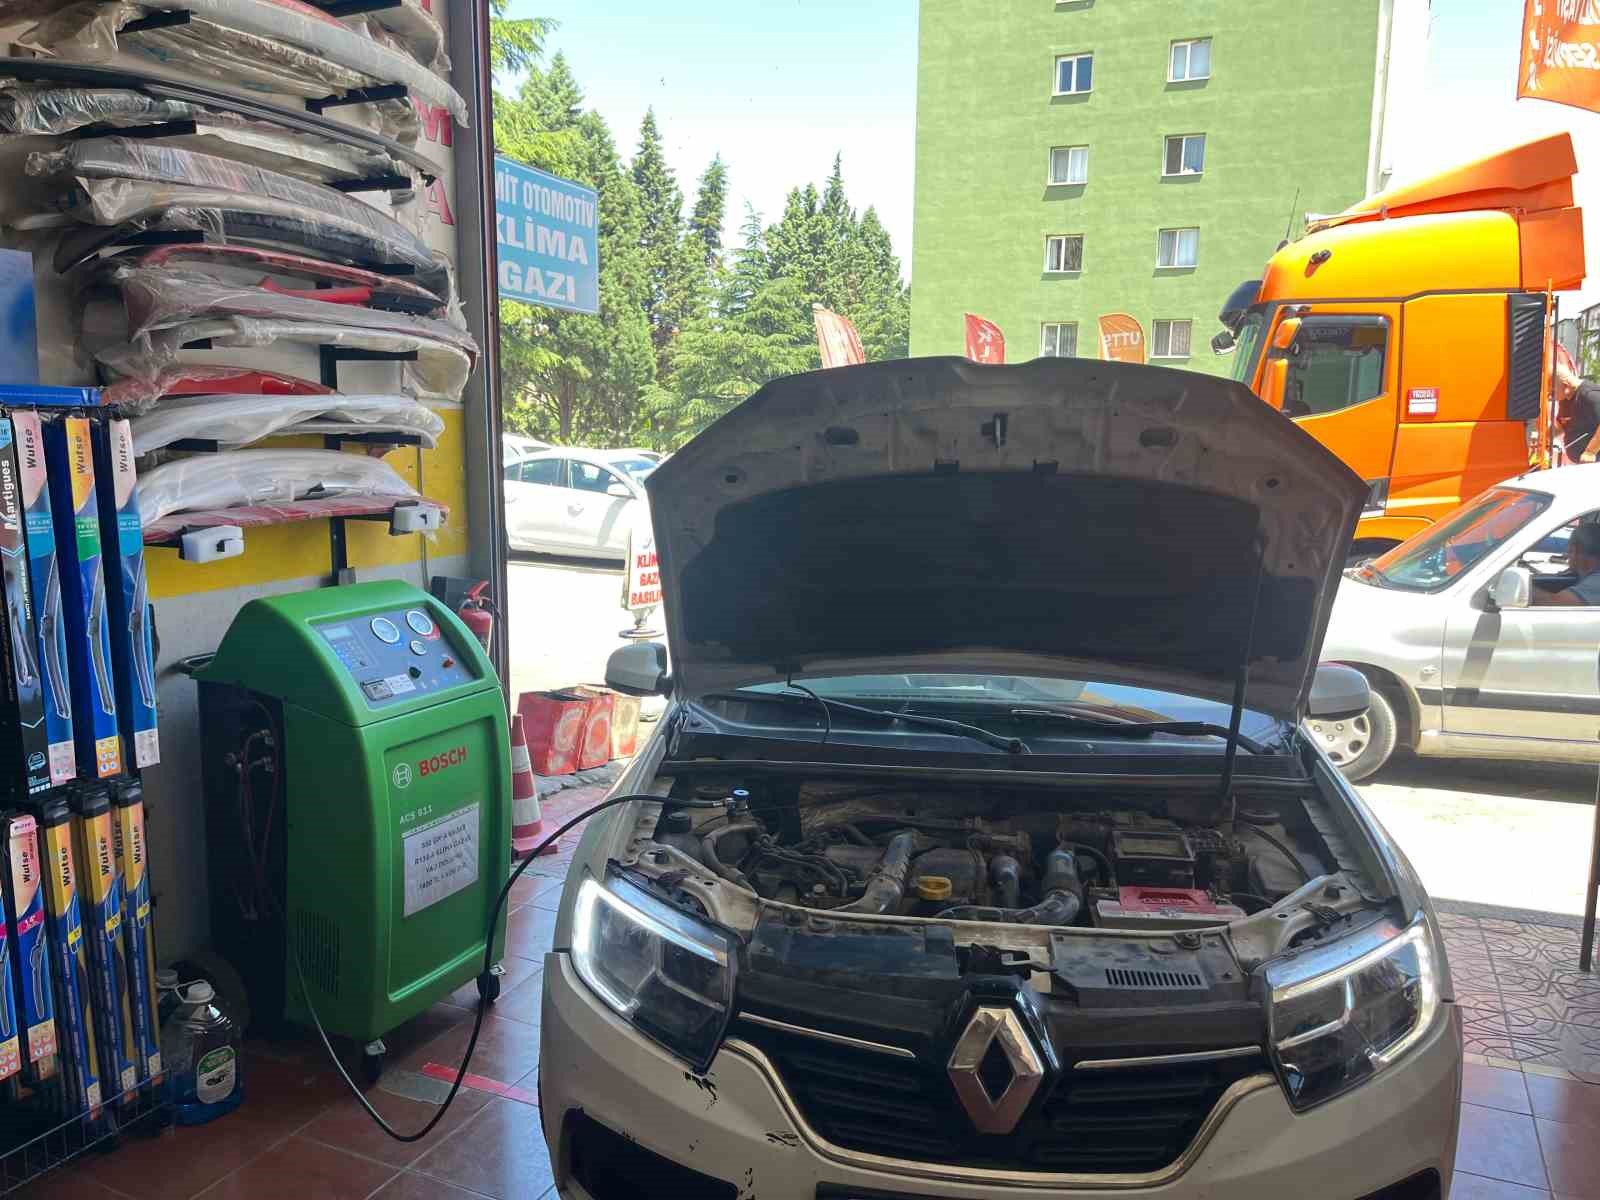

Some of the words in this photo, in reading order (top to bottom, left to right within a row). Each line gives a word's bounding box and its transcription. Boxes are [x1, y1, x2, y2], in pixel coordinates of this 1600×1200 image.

[25, 428, 37, 468] Wutse
[76, 435, 86, 473] Wutse
[119, 435, 130, 472] Wutse
[418, 746, 467, 777] BOSCH
[101, 837, 110, 876] Wutse
[133, 826, 141, 863] Wutse
[22, 852, 31, 883] Wutse
[61, 847, 71, 887] Wutse
